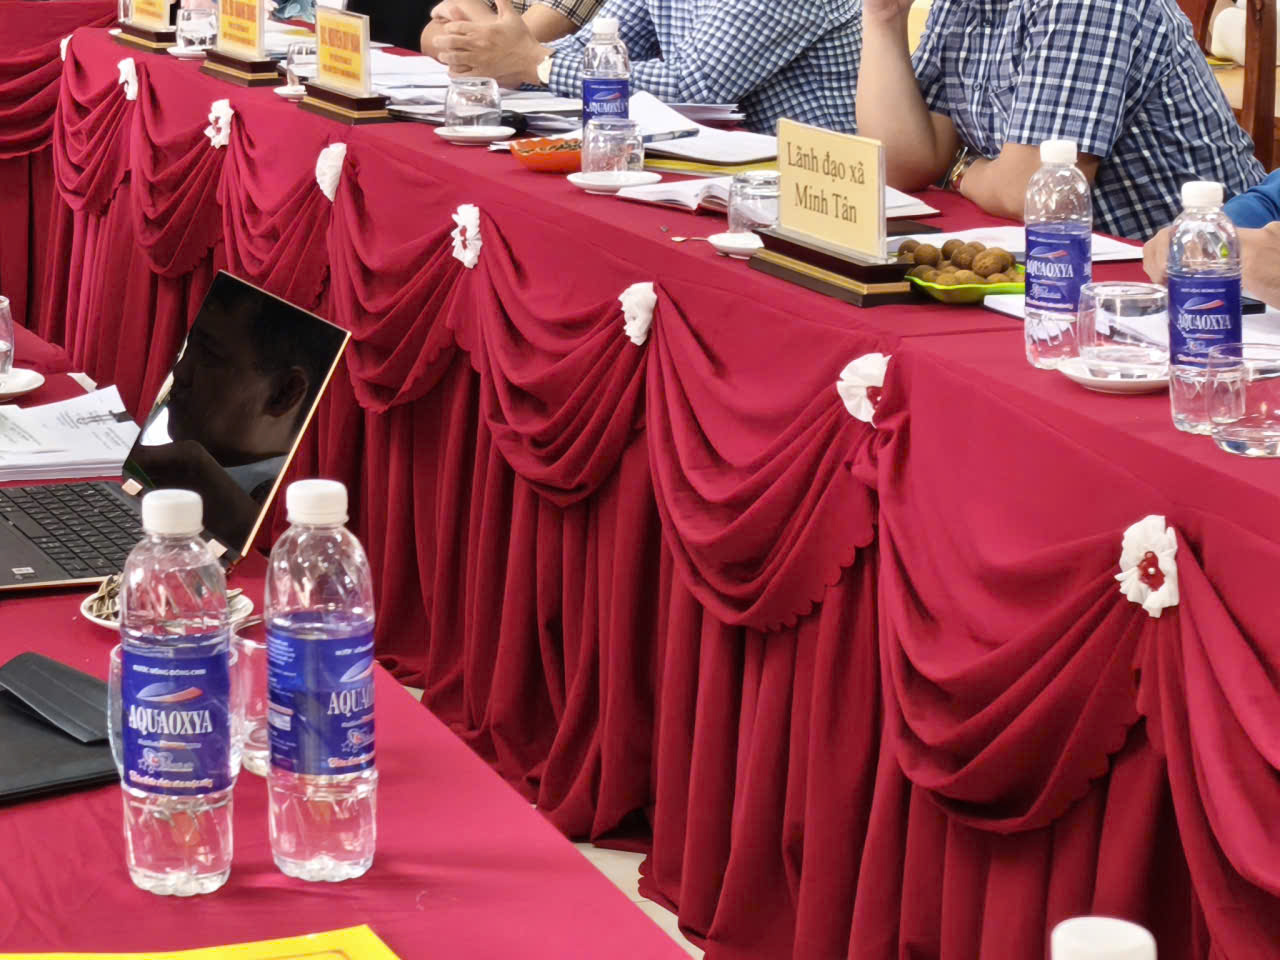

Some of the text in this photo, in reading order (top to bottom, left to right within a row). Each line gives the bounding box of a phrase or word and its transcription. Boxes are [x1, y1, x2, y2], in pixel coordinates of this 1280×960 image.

[787, 141, 865, 185] Lãnh đạo xã
[795, 182, 857, 224] Minh Tân
[1026, 259, 1074, 278] AQUAOXYA
[1178, 312, 1232, 332] AQUAOXYA
[128, 704, 214, 736] AQUAOXYA
